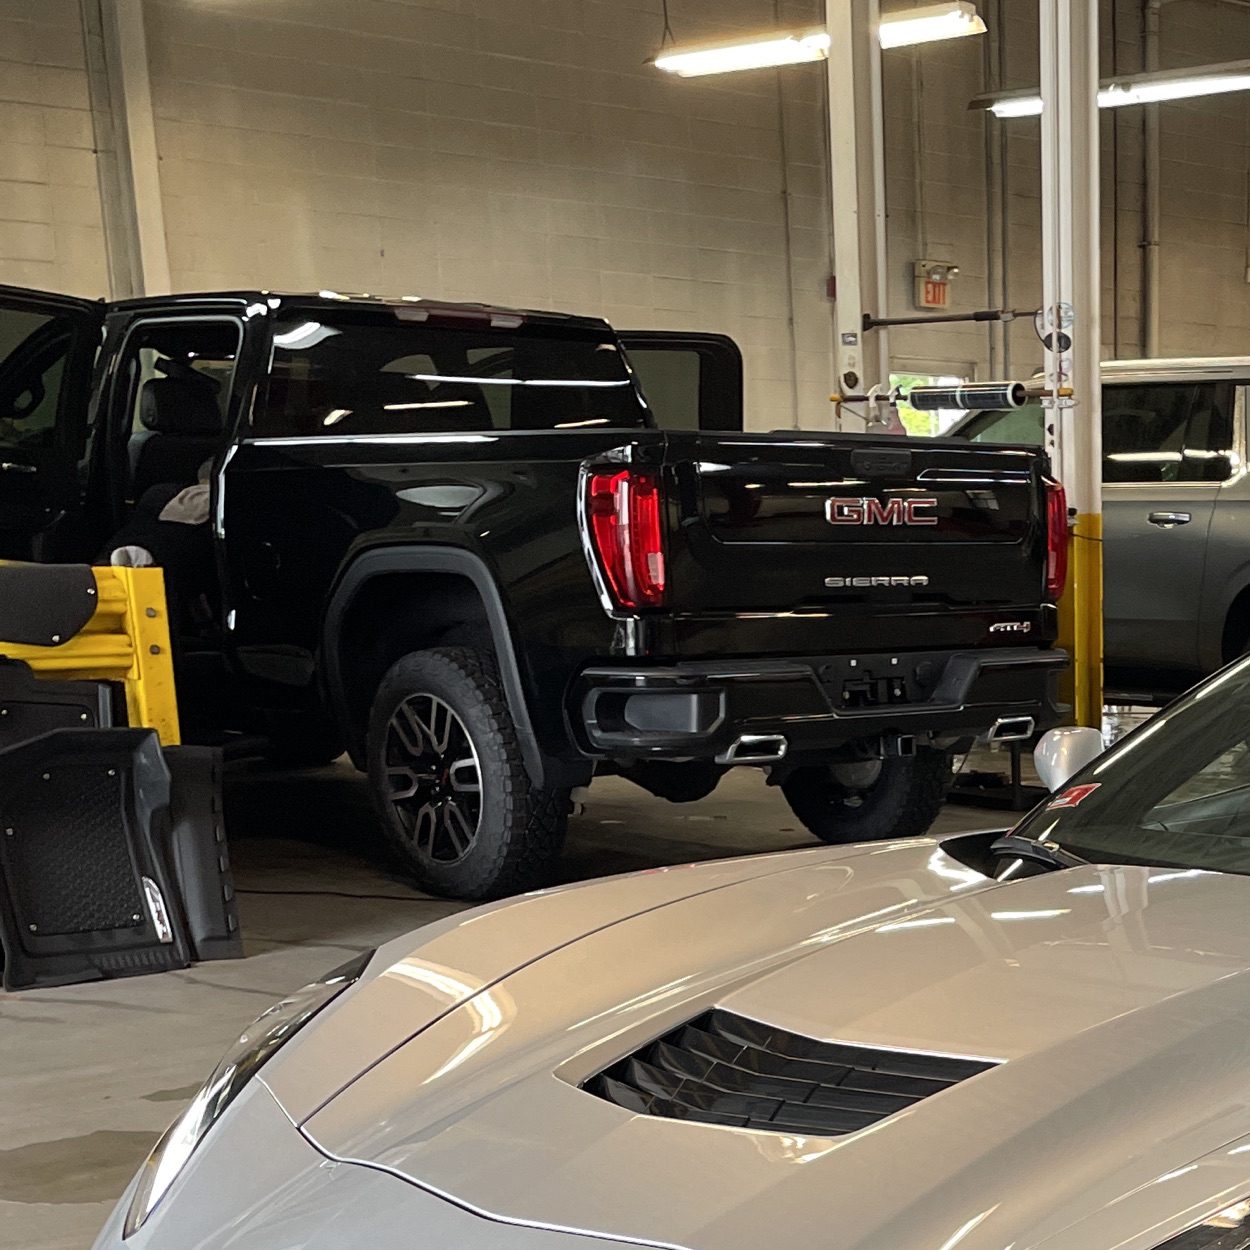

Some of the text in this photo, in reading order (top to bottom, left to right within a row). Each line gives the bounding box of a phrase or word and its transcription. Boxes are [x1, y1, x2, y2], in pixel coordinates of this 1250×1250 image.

[924, 280, 947, 305] EXIT
[824, 496, 939, 526] GMC
[824, 575, 930, 588] SIERRA
[989, 621, 1031, 633] AT4
